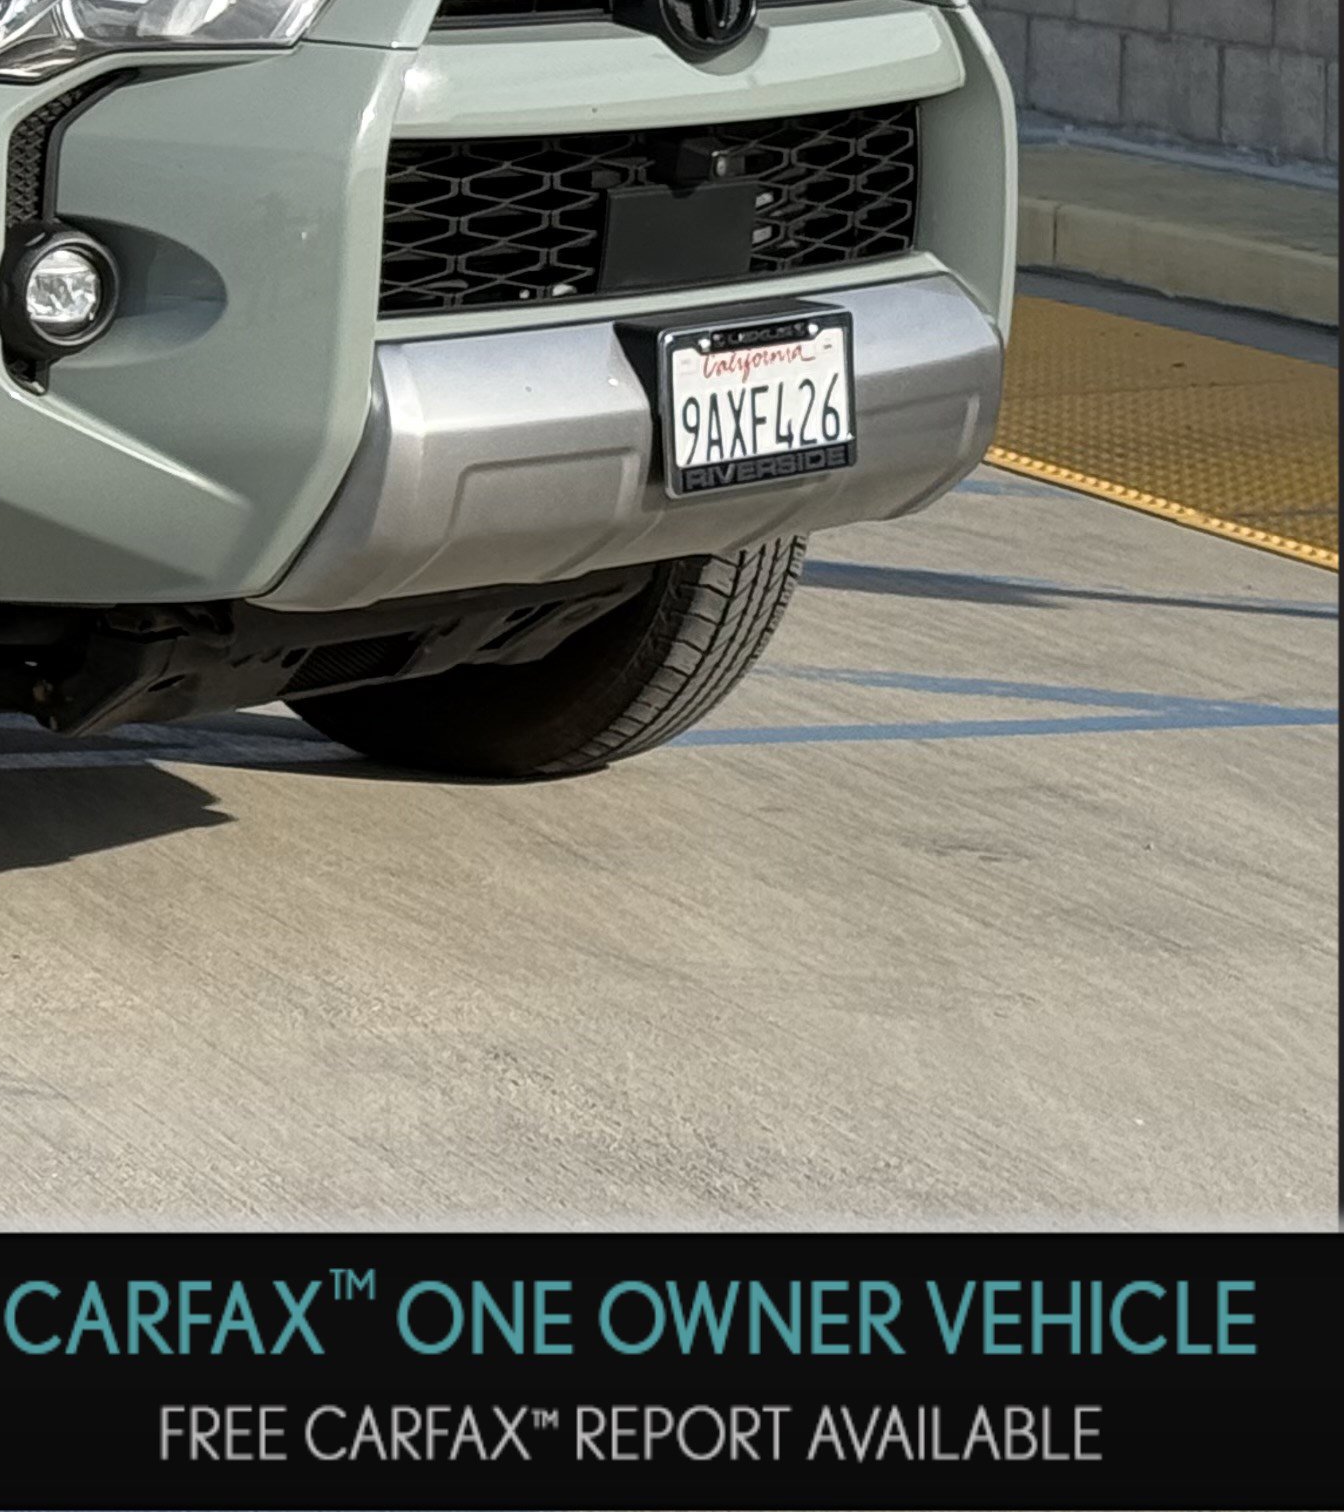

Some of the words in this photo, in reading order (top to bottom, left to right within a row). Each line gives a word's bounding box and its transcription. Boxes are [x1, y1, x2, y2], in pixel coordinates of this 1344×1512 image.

[702, 342, 816, 383] California
[681, 372, 841, 465] 9AXF426
[685, 446, 848, 491] RIVERSIDE
